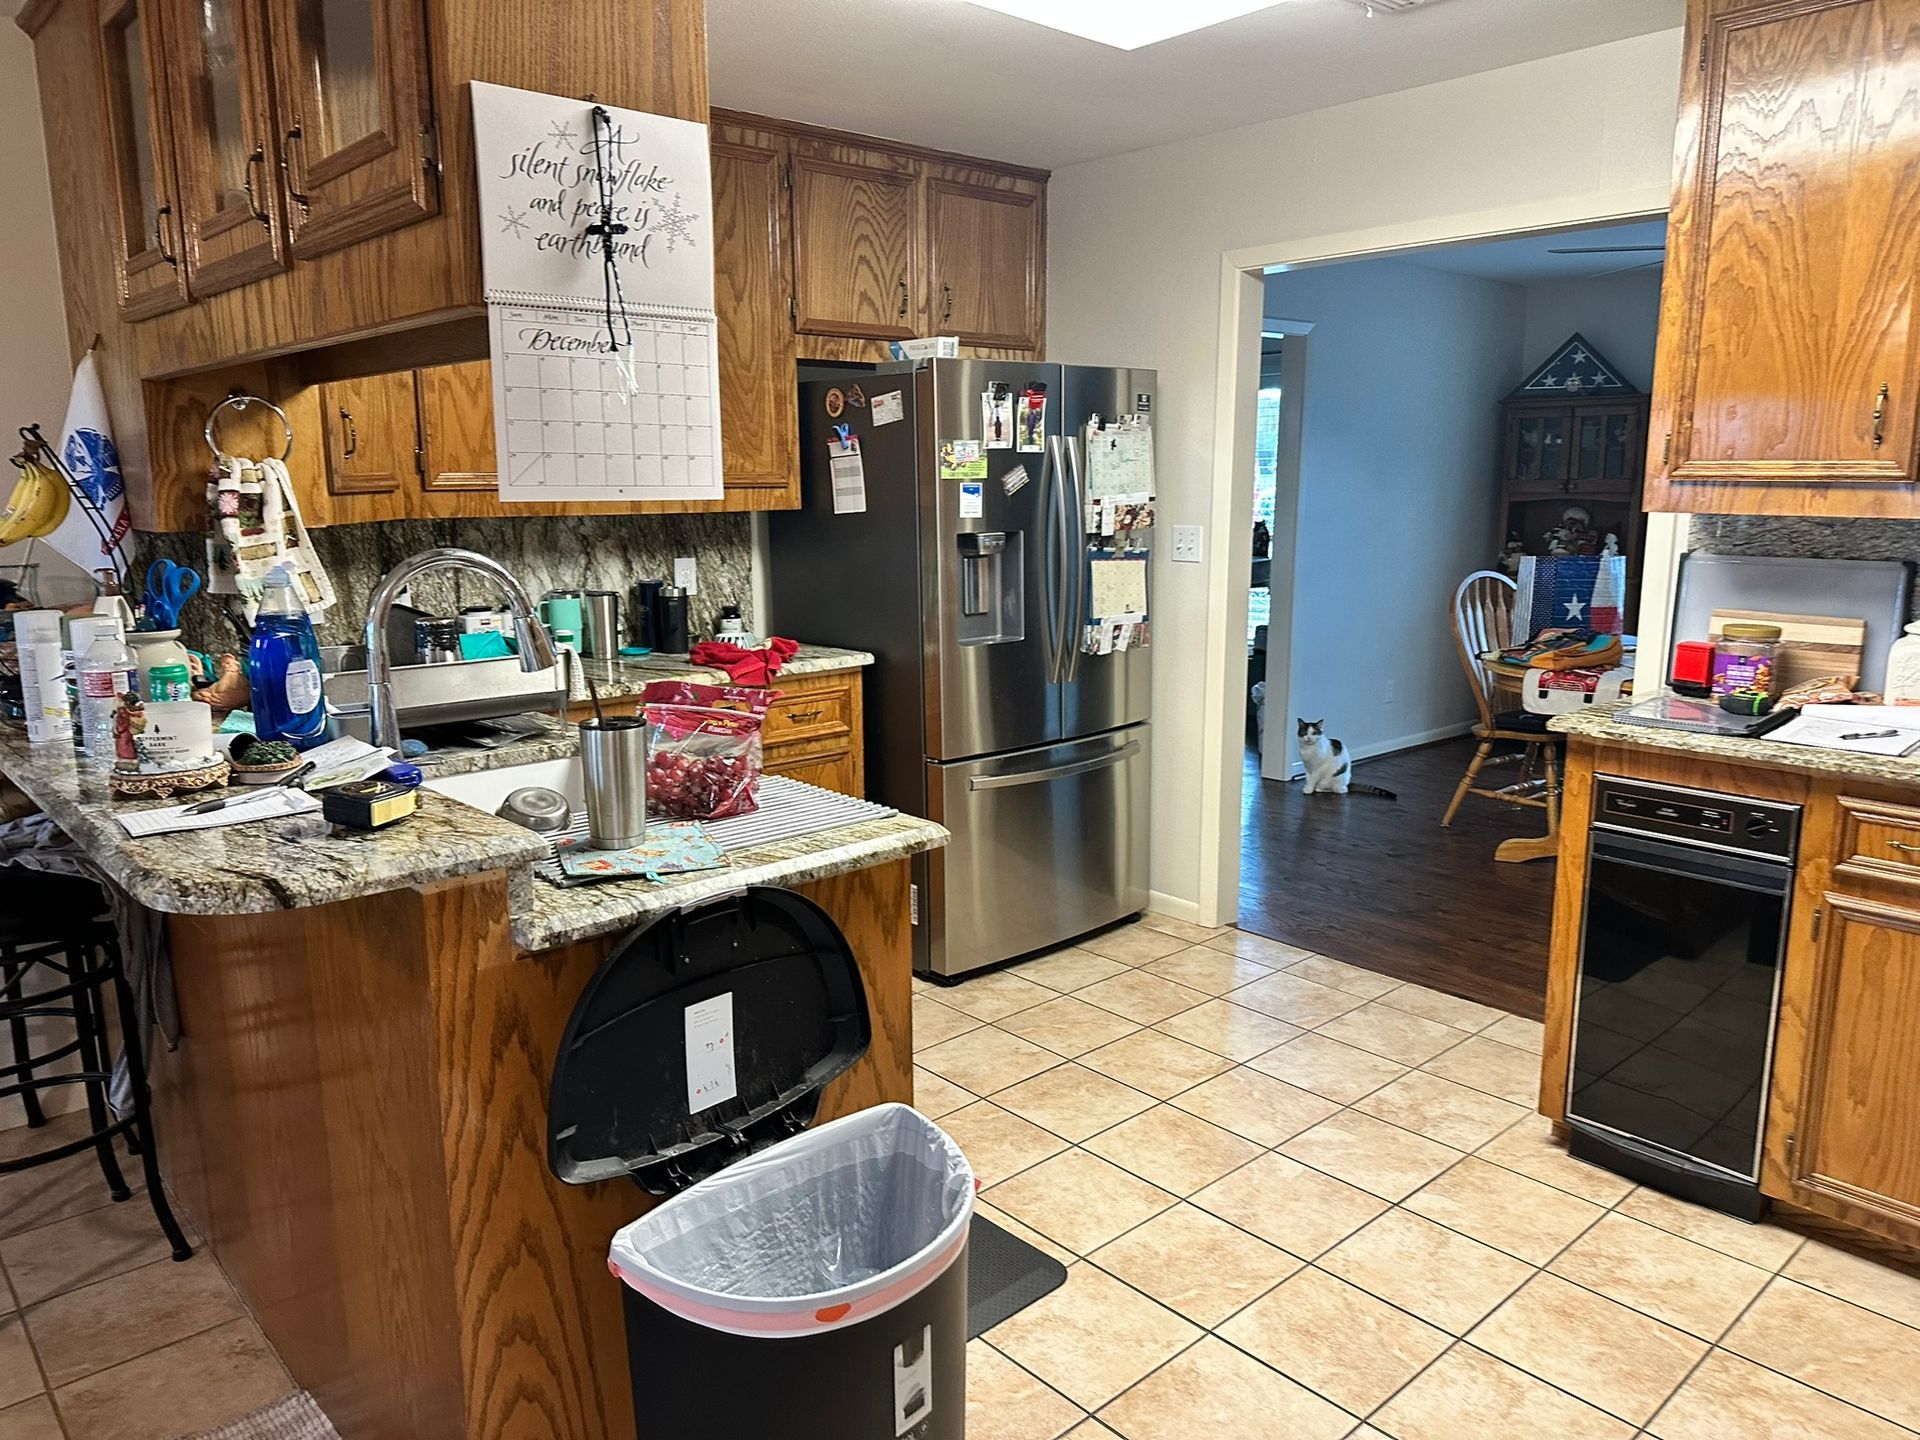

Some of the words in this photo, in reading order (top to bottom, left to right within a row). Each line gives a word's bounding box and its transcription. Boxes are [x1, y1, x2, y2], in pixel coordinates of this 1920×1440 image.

[579, 124, 640, 165] A
[499, 140, 569, 184] silent
[569, 159, 673, 193] snowflake
[529, 189, 567, 221] and
[633, 200, 652, 231] is
[534, 231, 650, 268] earthbund
